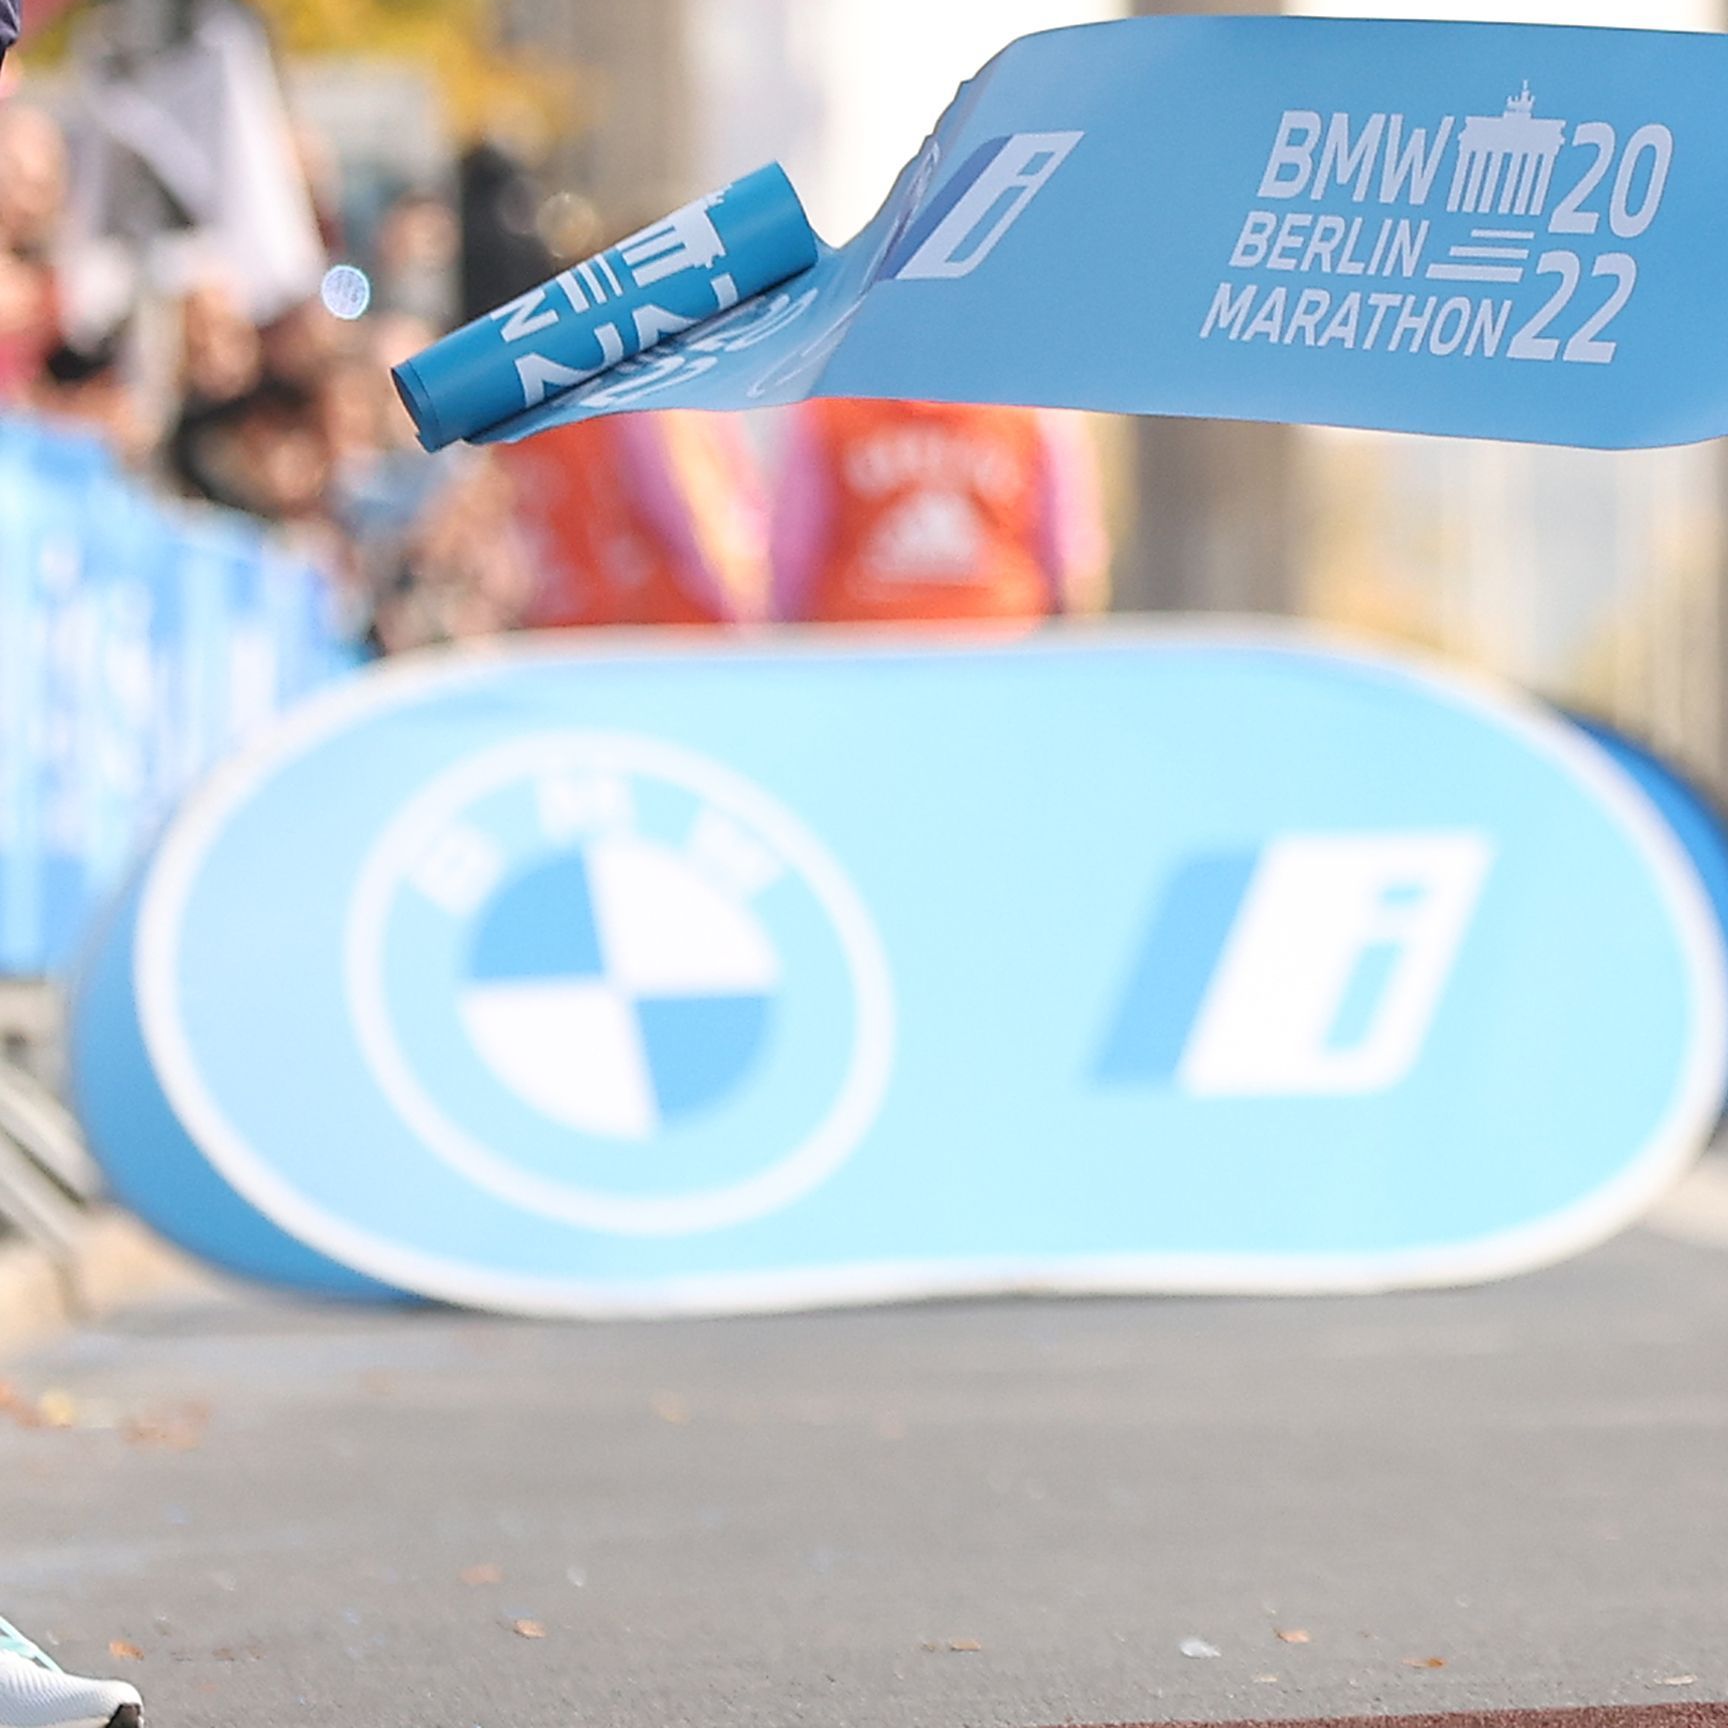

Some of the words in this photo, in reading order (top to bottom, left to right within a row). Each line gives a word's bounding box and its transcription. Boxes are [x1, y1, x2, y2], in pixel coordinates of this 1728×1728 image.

[1256, 109, 1455, 206] BMW
[1547, 120, 1674, 240] 20
[1228, 209, 1430, 278] BERLIN
[1199, 281, 1512, 359] MARATHON
[1505, 249, 1638, 365] 22
